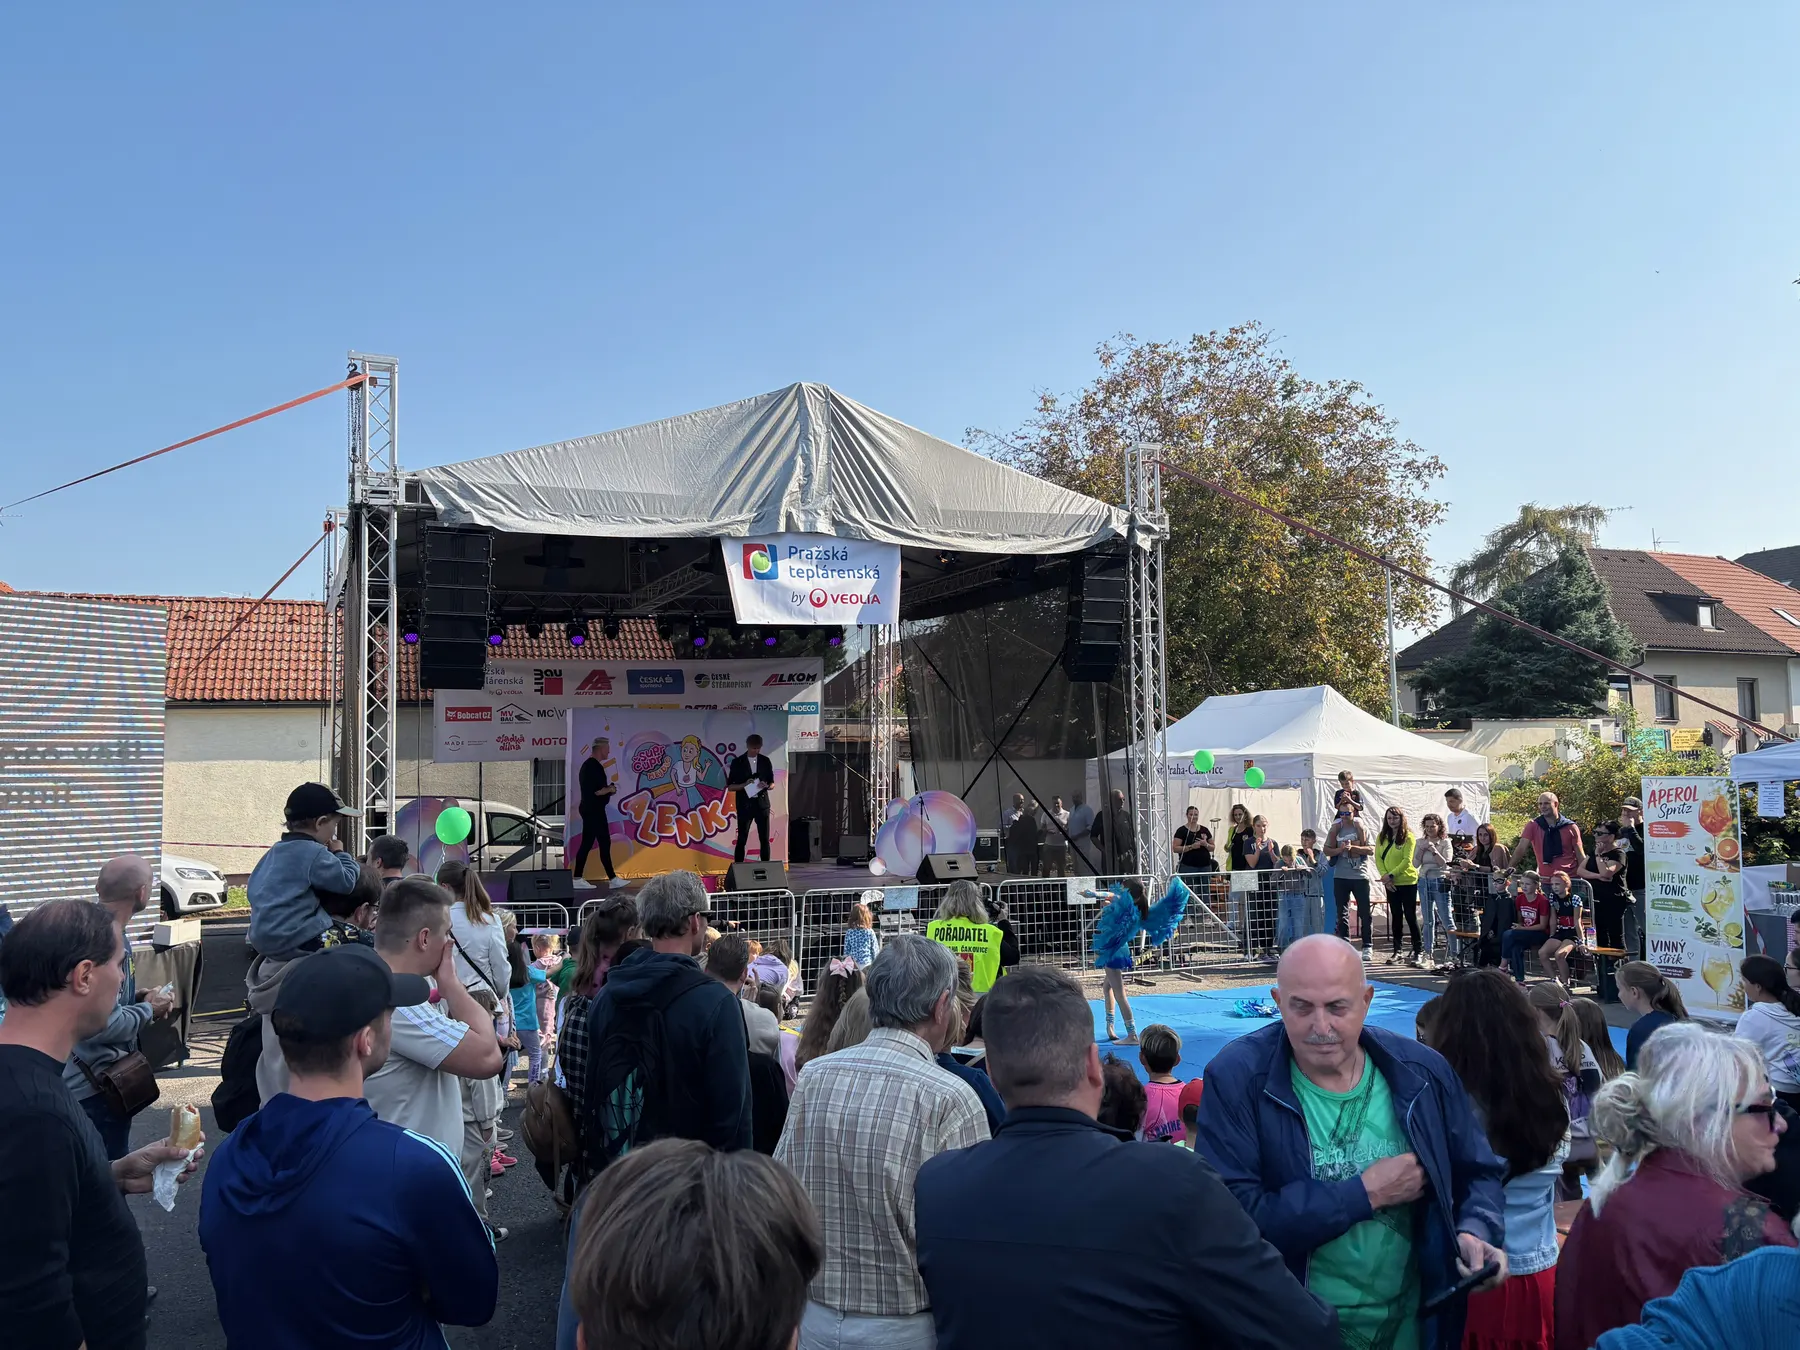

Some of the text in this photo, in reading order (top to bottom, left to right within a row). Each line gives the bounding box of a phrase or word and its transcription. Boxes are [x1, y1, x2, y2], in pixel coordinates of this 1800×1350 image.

[788, 545, 848, 561] Pražská
[789, 565, 880, 581] teplárenská
[791, 591, 881, 607] by VEOLIA
[485, 676, 524, 685] lárenská
[639, 675, 664, 683] ČESKÁ
[762, 673, 817, 686] ALKOM
[457, 711, 491, 719] Bobcat CZ
[1647, 785, 1699, 809] APEROL
[1657, 802, 1692, 819] Spritz
[1650, 872, 1699, 885] WHITE WINE
[1659, 884, 1687, 897] TONIC
[935, 924, 988, 942] POŘADATEL
[961, 945, 988, 953] ČAKOVICE
[1651, 939, 1686, 953] VINNÝ
